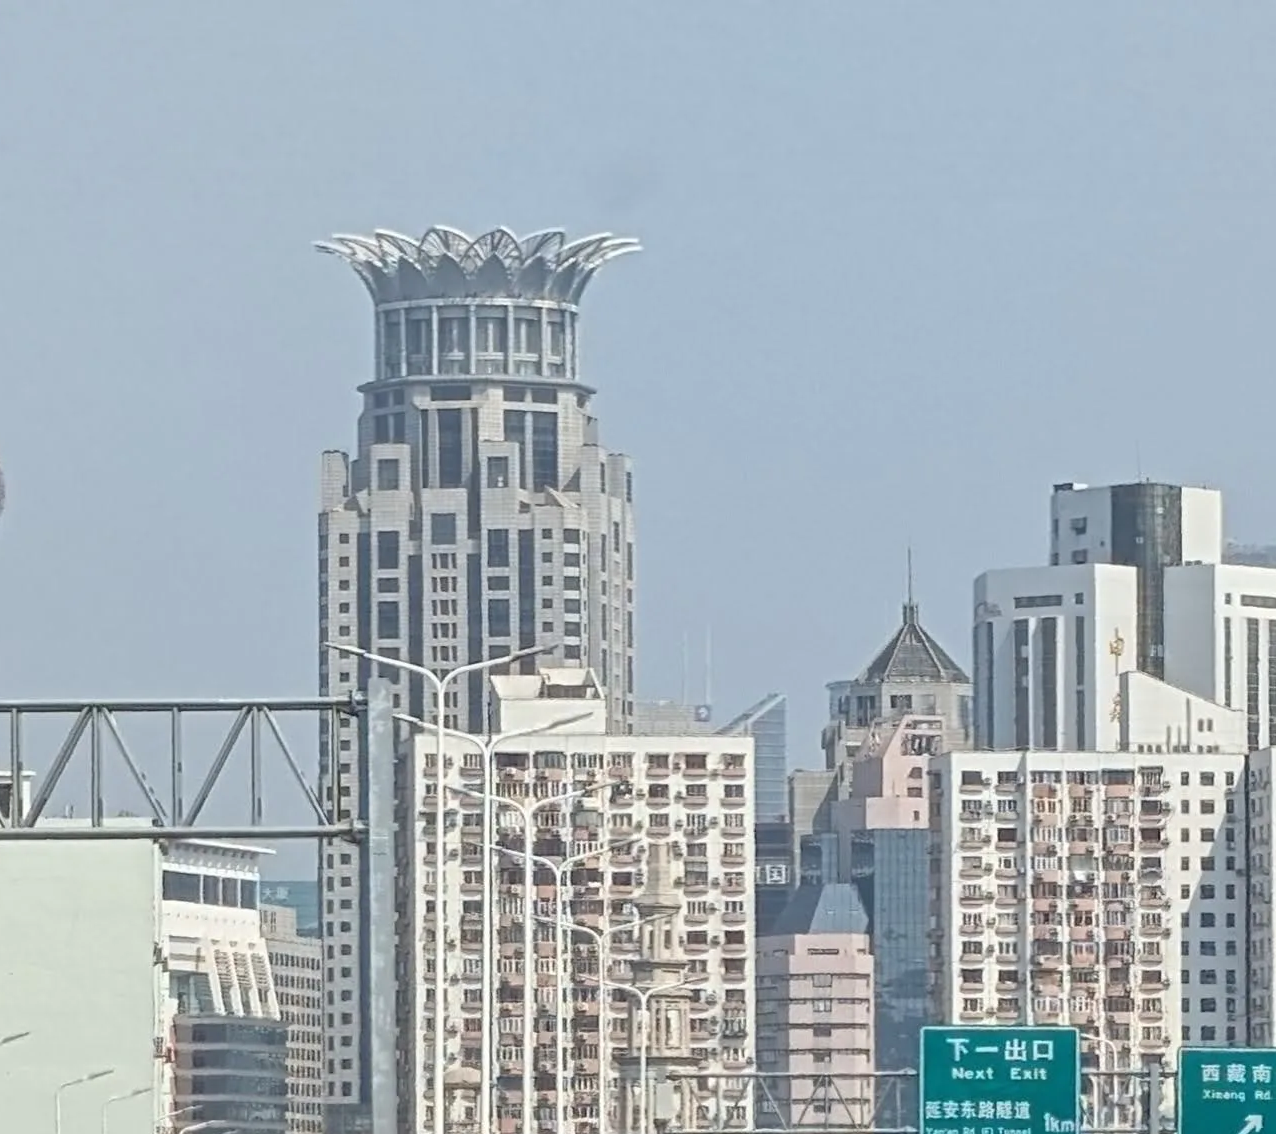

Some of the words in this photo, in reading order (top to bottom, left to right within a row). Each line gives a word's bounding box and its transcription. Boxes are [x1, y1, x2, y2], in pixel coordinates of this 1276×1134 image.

[946, 1038, 1054, 1061] 下一出口
[952, 1067, 994, 1080] Next
[1010, 1067, 1047, 1080] Exit
[1202, 1089, 1246, 1102] Xizang
[925, 1101, 1031, 1119] 延安东路隧道
[1044, 1113, 1075, 1132] 1km
